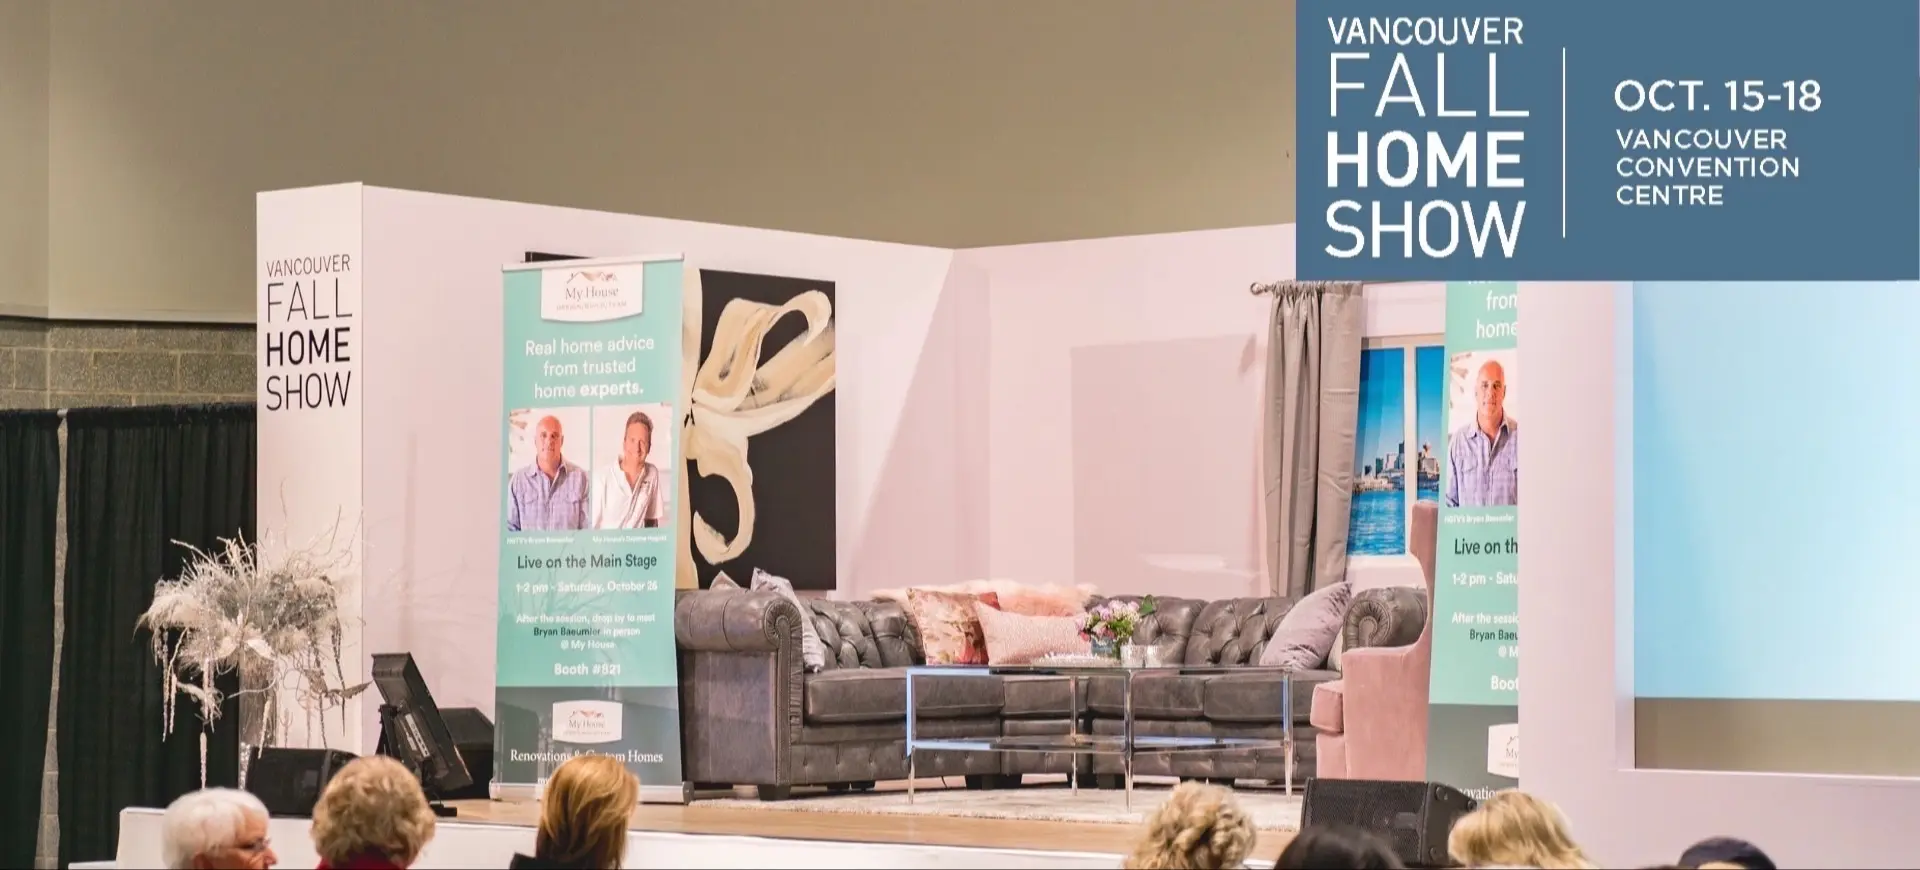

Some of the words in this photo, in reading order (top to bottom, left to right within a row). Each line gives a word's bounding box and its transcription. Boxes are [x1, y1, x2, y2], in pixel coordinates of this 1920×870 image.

[266, 254, 351, 278] VANCOUVER
[268, 277, 352, 323] FALL
[565, 287, 583, 302] My
[586, 285, 619, 298] House
[1476, 318, 1519, 339] home
[267, 327, 350, 367] HOME
[525, 338, 556, 356] Real
[561, 338, 603, 355] home
[607, 335, 654, 351] advice
[543, 360, 578, 376] from
[583, 357, 636, 375] trusted
[266, 371, 351, 411] SHOW
[534, 382, 576, 399] home
[580, 380, 644, 399] experts.
[1454, 538, 1480, 555] Live
[1484, 542, 1501, 555] on
[517, 555, 542, 569] Live
[546, 558, 562, 569] on
[565, 555, 586, 568] the
[590, 554, 622, 568] Main
[625, 553, 657, 570] Stage
[532, 583, 548, 596] pm
[557, 581, 605, 594] Saturday,
[607, 580, 645, 592] October
[1453, 573, 1467, 585] 1-2
[1469, 574, 1486, 588] pm
[1452, 612, 1475, 624] After
[1477, 613, 1491, 624] the
[533, 627, 558, 639] Bryan
[1470, 629, 1495, 642] Bryan
[571, 639, 585, 651] My
[588, 639, 616, 649] House
[554, 663, 589, 676] Booth
[510, 749, 572, 763] Renovations
[628, 749, 663, 763] Homes
